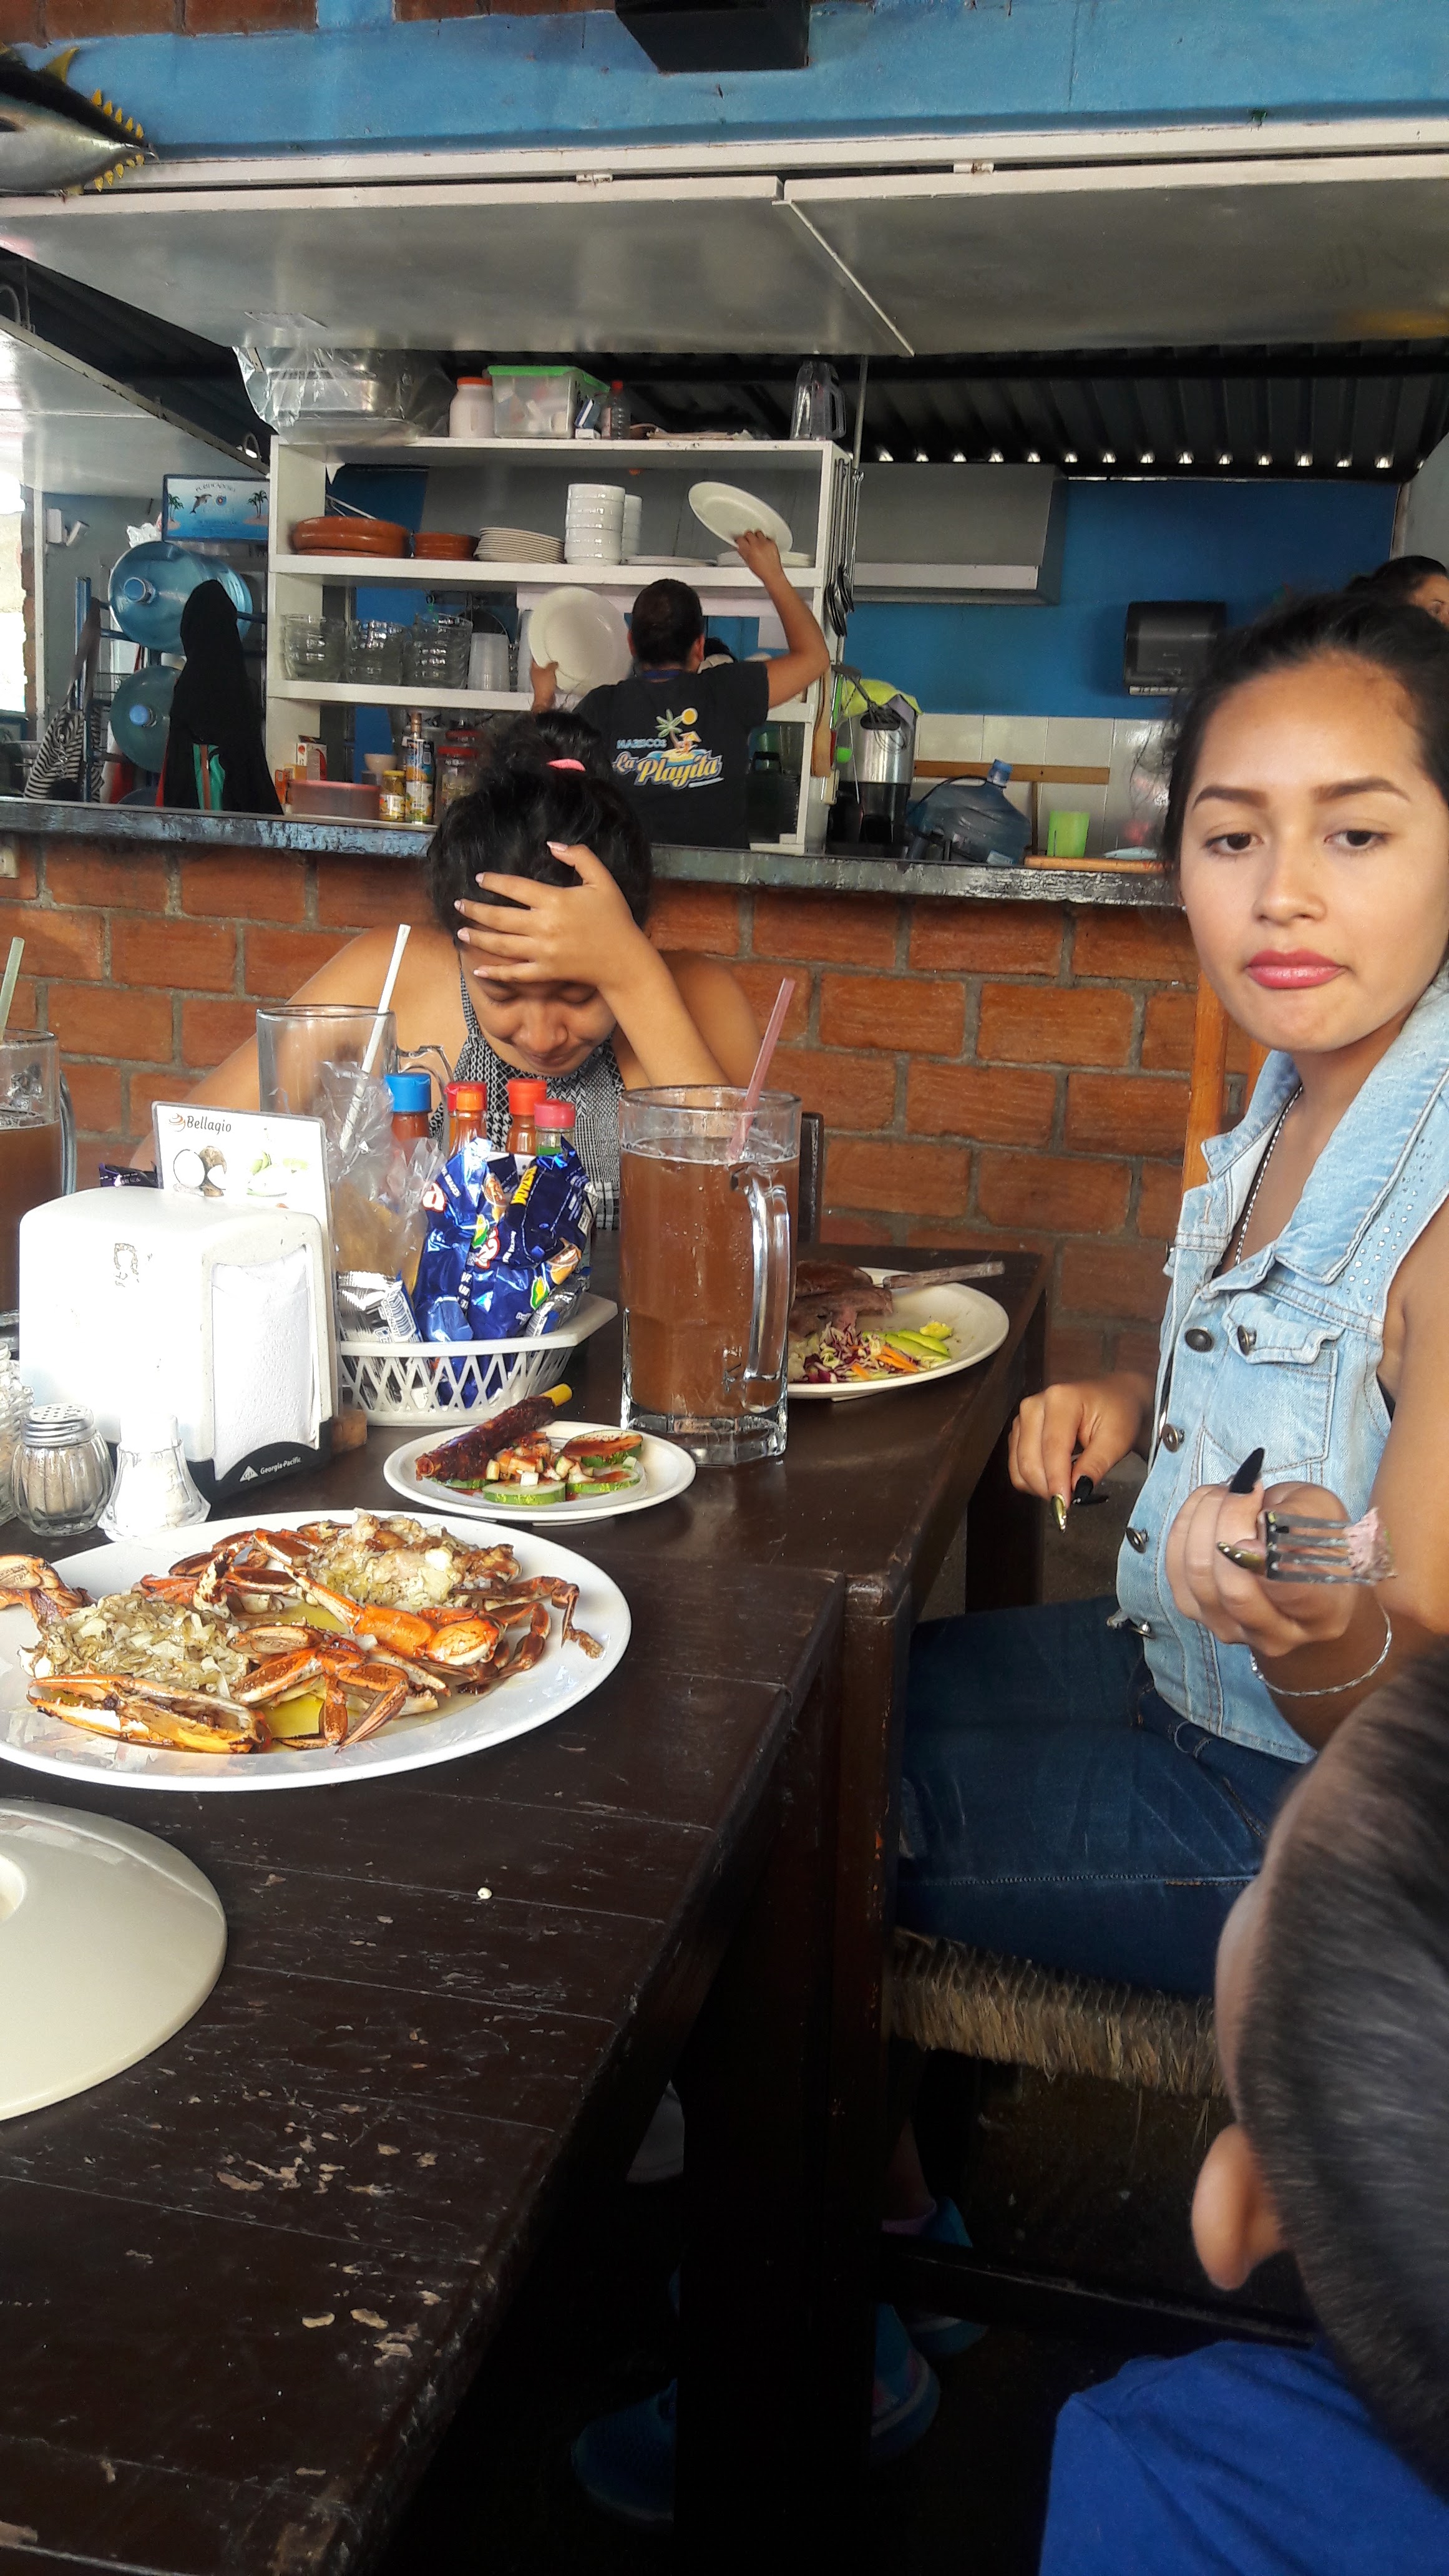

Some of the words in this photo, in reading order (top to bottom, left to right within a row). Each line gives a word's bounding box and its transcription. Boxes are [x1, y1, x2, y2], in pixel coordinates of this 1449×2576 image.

[613, 752, 638, 775] La
[634, 754, 721, 789] Playita
[187, 1116, 232, 1135] Bellagio
